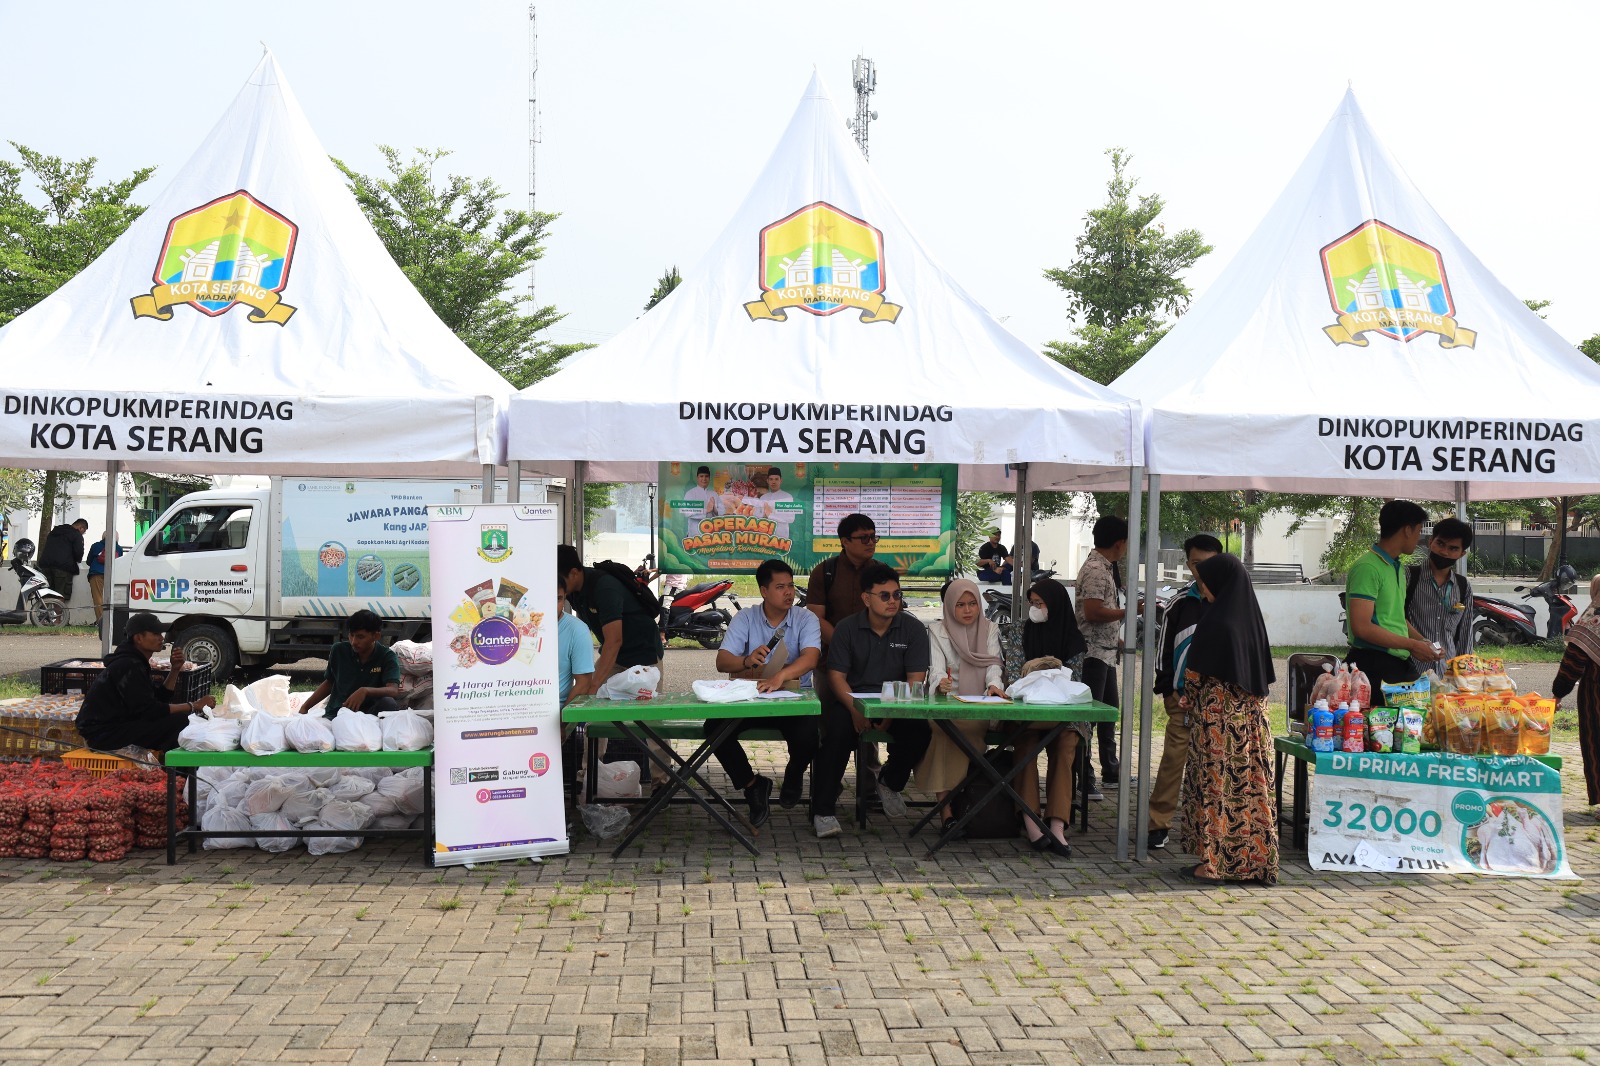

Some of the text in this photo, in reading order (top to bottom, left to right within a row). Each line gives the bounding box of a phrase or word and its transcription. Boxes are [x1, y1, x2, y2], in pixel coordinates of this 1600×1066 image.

[170, 282, 267, 300] KOTA SERANG
[196, 293, 237, 301] MADANI
[777, 286, 870, 301] KOTA SERANG
[803, 295, 843, 304] MADANI
[1352, 311, 1388, 324] KOTA
[4, 394, 294, 421] DINKOPUKMPERINDAG
[679, 401, 953, 423] DINKOPUKMPERINDAG
[1318, 417, 1584, 443] DINKOPUKMPERINDAG
[30, 422, 264, 454] KOTA SERANG
[707, 427, 926, 456] KOTA SERANG
[1344, 444, 1557, 474] KOTA SERANG
[346, 507, 392, 523] JAWARA
[436, 506, 463, 516] ABM
[383, 522, 407, 533] Kang
[699, 517, 776, 535] OPERASI
[683, 532, 791, 552] PASAR MURAH
[193, 579, 244, 587] Gerakan Nasional
[194, 588, 232, 596] Pengendalian
[194, 596, 216, 604] Pangan
[462, 681, 494, 690] Harga
[459, 687, 544, 701] Inflasi Terkendali
[463, 729, 535, 738] www.warungbanten.com
[502, 769, 529, 777] Gabung
[1332, 754, 1545, 788] DI PRIMA FRESHMART
[1454, 803, 1484, 812] PROMO
[1322, 800, 1443, 837] 32000
[1411, 844, 1445, 854] per ekor
